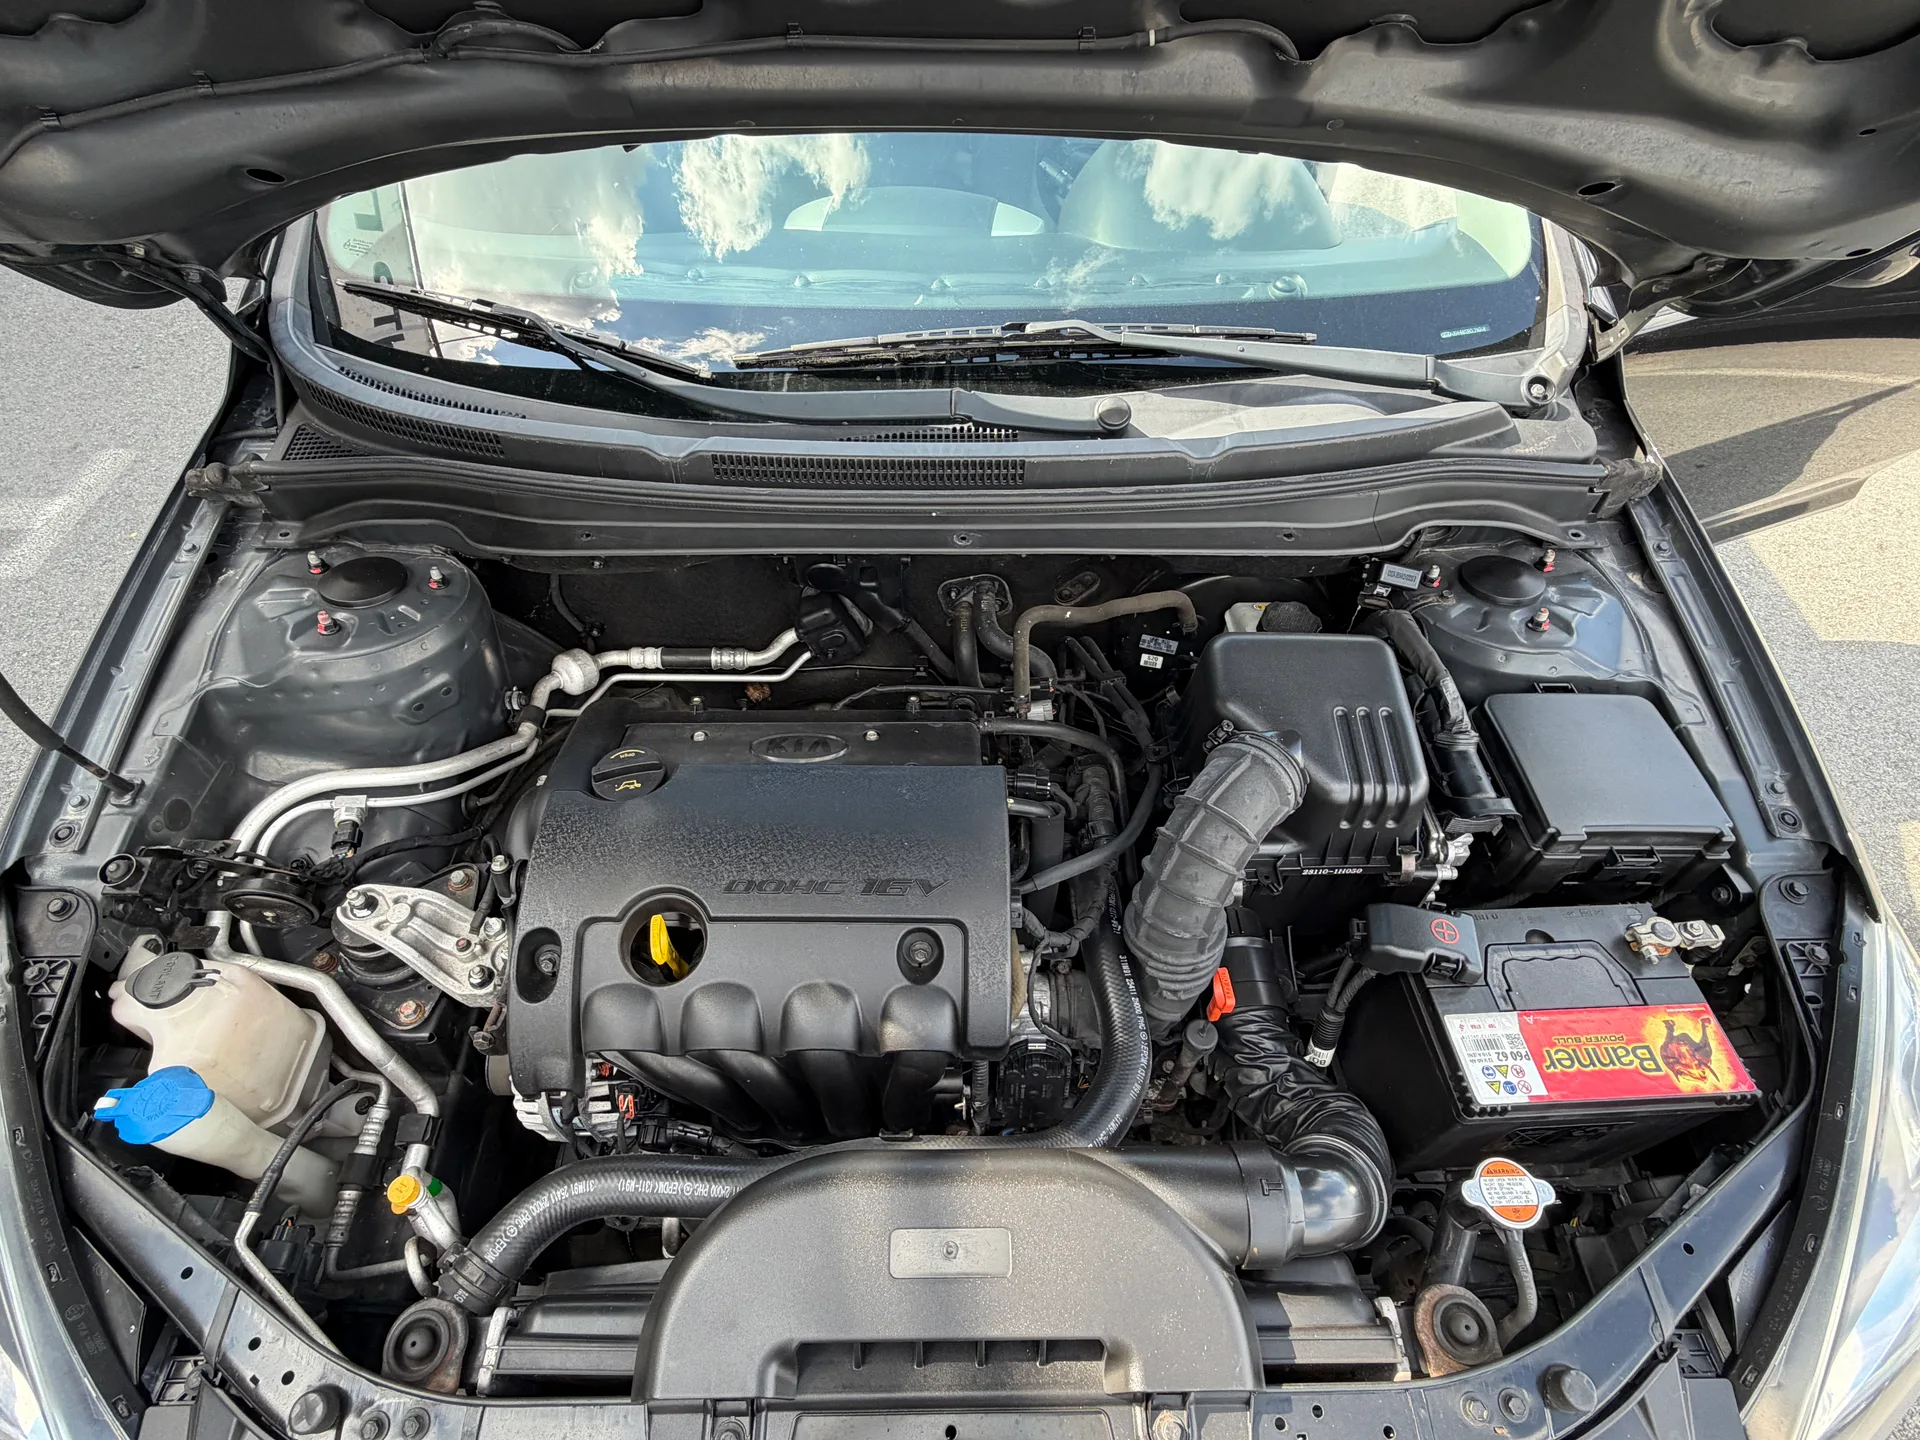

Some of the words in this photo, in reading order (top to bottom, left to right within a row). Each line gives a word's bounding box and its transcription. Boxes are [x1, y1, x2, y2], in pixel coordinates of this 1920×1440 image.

[766, 736, 831, 753] KIA
[722, 878, 850, 895] DOHC
[860, 877, 951, 898] 16V
[149, 955, 179, 998] COOLANT
[1554, 1036, 1582, 1044] BULL
[1584, 1035, 1625, 1043] POWER
[1495, 1051, 1509, 1062] 62
[1510, 1050, 1531, 1061] P60
[1545, 1045, 1664, 1073] Banner
[550, 1185, 569, 1204] 25411
[694, 1183, 709, 1197] PHC
[515, 1210, 532, 1229] PHC
